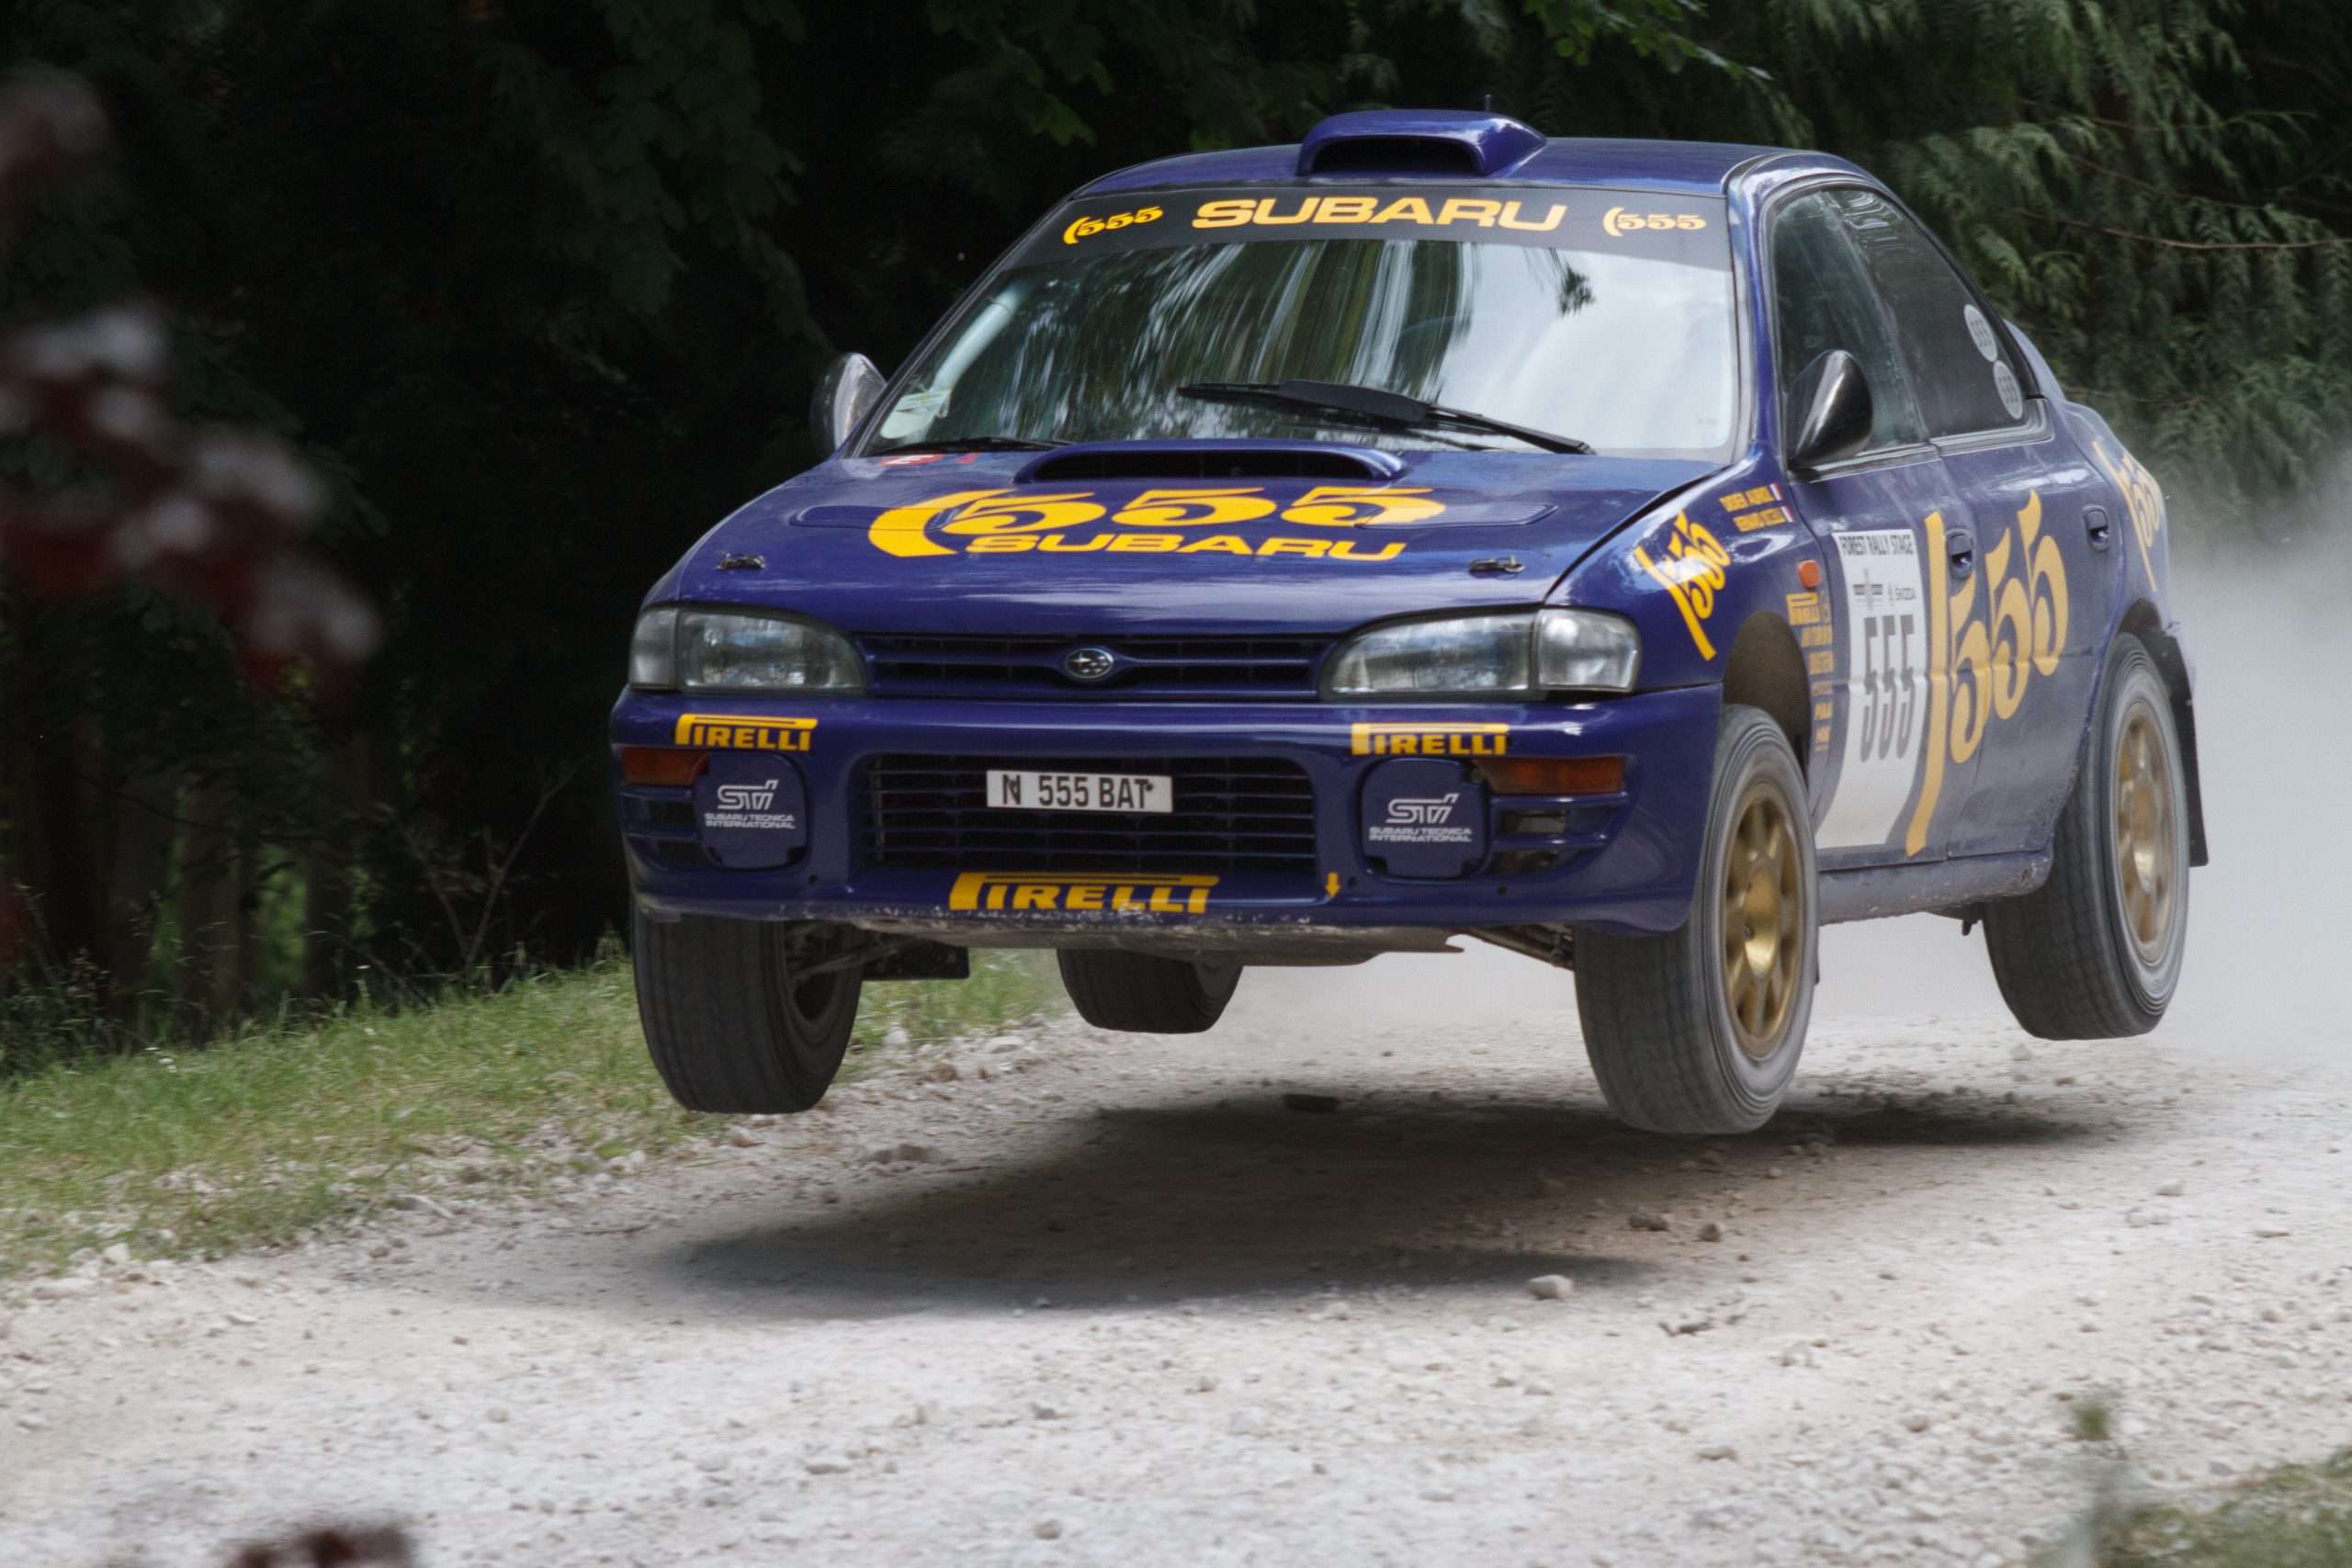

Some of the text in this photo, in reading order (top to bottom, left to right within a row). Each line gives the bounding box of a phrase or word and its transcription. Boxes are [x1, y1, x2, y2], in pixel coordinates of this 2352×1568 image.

[1192, 196, 1567, 231] SUBARU
[965, 534, 1407, 561] SUBARU
[1838, 534, 1914, 556] FOREST RALLY STAGE
[1859, 614, 1916, 763] 555
[674, 713, 819, 751] PIRELLI
[1351, 722, 1510, 756] PIRELLI
[1038, 774, 1089, 807] 555
[1099, 776, 1148, 809] BAT
[705, 812, 748, 822] SUBARU
[705, 819, 796, 829] INTERNATIONAL
[1369, 827, 1419, 836] SUBARU
[1369, 834, 1472, 842] INTERNATIONAL
[949, 872, 1220, 913] PIRELLI
